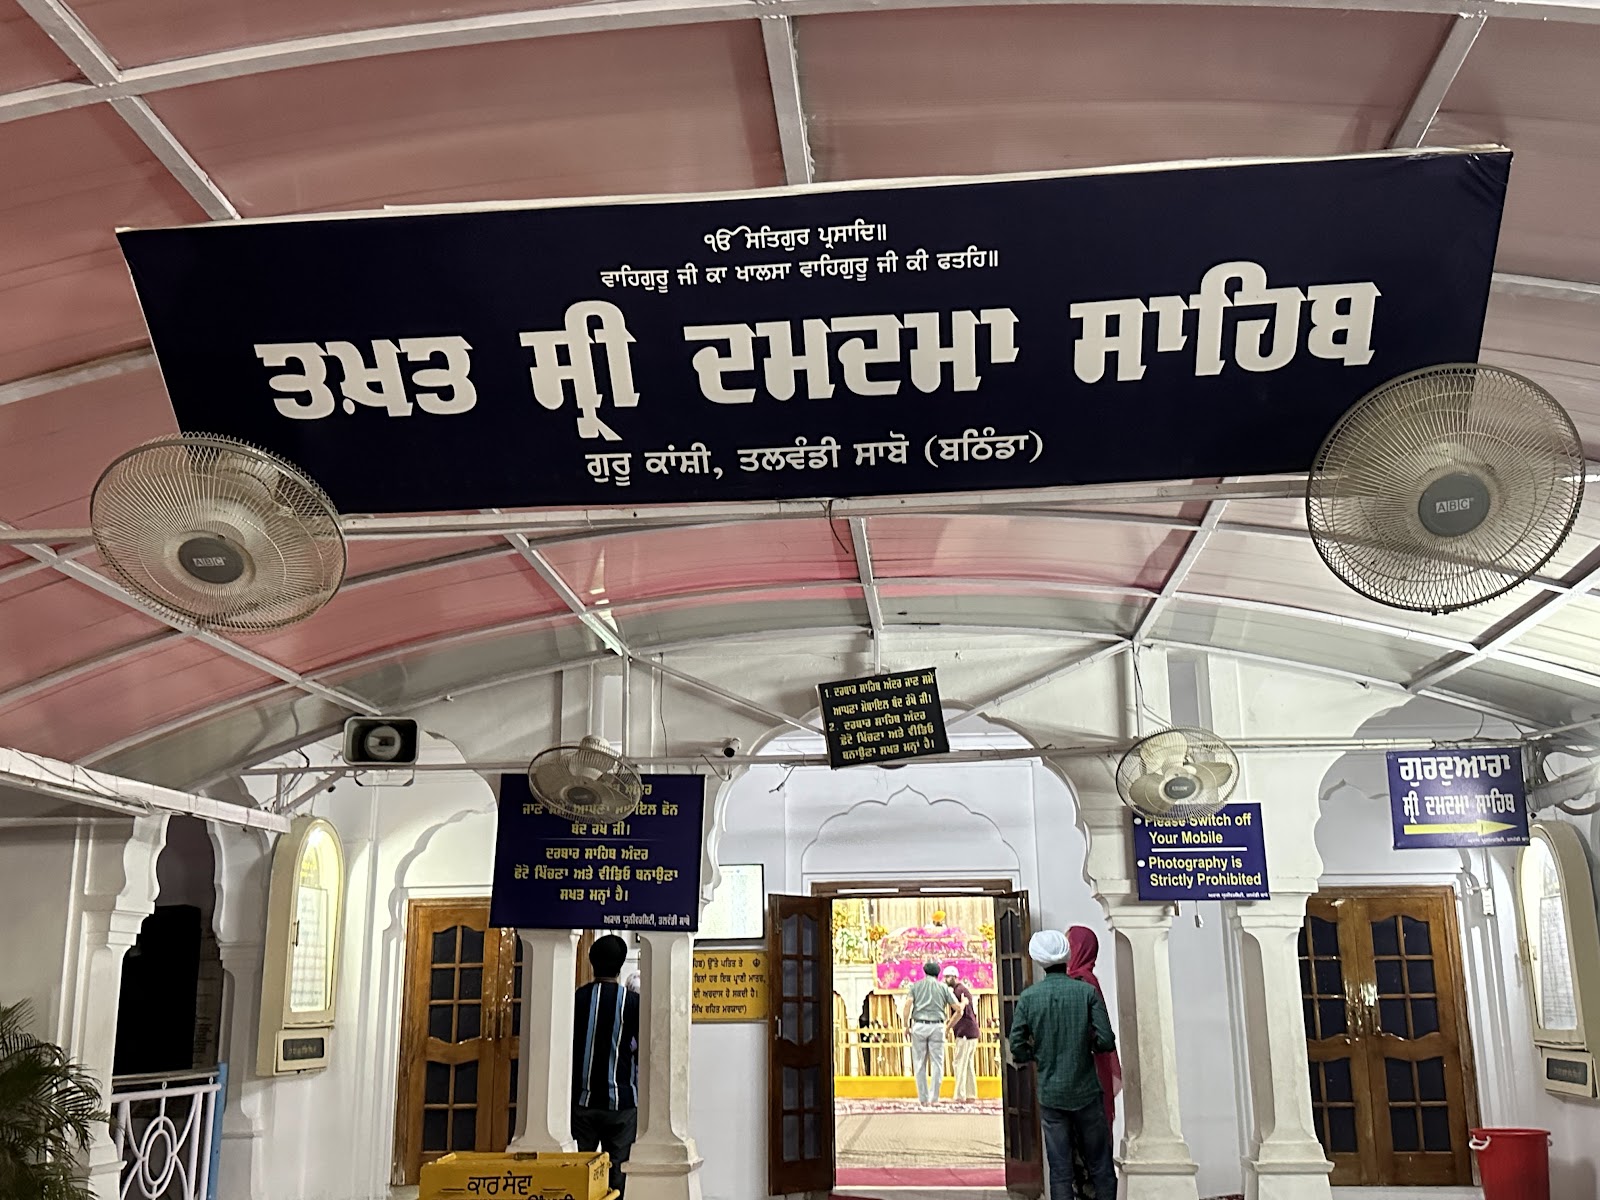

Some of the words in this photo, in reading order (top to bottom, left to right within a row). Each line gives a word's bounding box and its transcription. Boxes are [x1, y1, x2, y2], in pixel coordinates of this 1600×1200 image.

[745, 225, 810, 251] ਸਤਿਗੁਰ
[601, 262, 668, 293] ਵਾਹਿਗੁਰੂ
[677, 261, 698, 286] ਜੀ
[706, 264, 728, 284] ਕਾ
[735, 262, 792, 283] ਖਾਲਸਾ
[799, 253, 869, 282] ਵਾਹਿਗੁਰੂ
[877, 250, 898, 275] ਜੀ
[906, 250, 929, 272] ਕੀ
[253, 335, 478, 420] ਤਖ਼ਤ
[519, 299, 641, 441] ਸ੍ਰੀ
[683, 307, 1020, 404] ਦਮਦਮਾ
[1070, 260, 1383, 384] ਸਾਹਿਬ
[585, 451, 632, 487] ਗੁਰੂ
[644, 442, 724, 480] ਕਾਂਸ਼ੀ,
[737, 436, 841, 473] ਤਲਵੰਡੀ
[853, 431, 909, 466] ਸਾਬੋ
[924, 426, 1044, 469] (ਬਠਿੰਡਾ)
[1436, 498, 1470, 513] ABC
[833, 685, 857, 697] ਦਰਬਾਰ
[859, 680, 881, 694] ਸਾਹਿਬ
[883, 677, 902, 691] ਅੰਦਰ
[904, 676, 920, 688] ਜਾਣ
[833, 704, 858, 716] ਆਪਣਾ
[892, 695, 903, 708] ਬੰਦ
[843, 718, 871, 731] ਦਰਬਾਰ
[874, 713, 901, 727] ਸਾਹਿਬ
[903, 709, 926, 723] ਅੰਦਰ
[887, 726, 904, 739] ਅਤੇ
[1398, 754, 1511, 787] ਗੁਰਦੁਆਰਾ
[1402, 790, 1420, 824] ਸ੍ਰੀ
[1424, 793, 1470, 816] ਦਮਦਮਾ
[1475, 787, 1516, 814] ਸਾਹਿਬ
[1189, 812, 1231, 827] Switch
[1234, 812, 1252, 826] off
[1149, 831, 1178, 844] Your
[1181, 830, 1223, 844] Mobile
[545, 847, 580, 860] ਦਰਬਾਰ
[584, 845, 616, 860] ਸਾਹਿਬ
[621, 845, 649, 860] ਅੰਦਰ
[514, 864, 530, 880] ਫੋਟੋ
[573, 865, 593, 880] ਅਤੇ
[1148, 856, 1228, 872] Photography
[1231, 855, 1243, 869] is
[1150, 873, 1194, 889] Strictly
[1197, 872, 1262, 887] Prohibited
[467, 1176, 502, 1195] ਕਾਰ
[502, 1171, 532, 1195] ਸੇਵਾ
